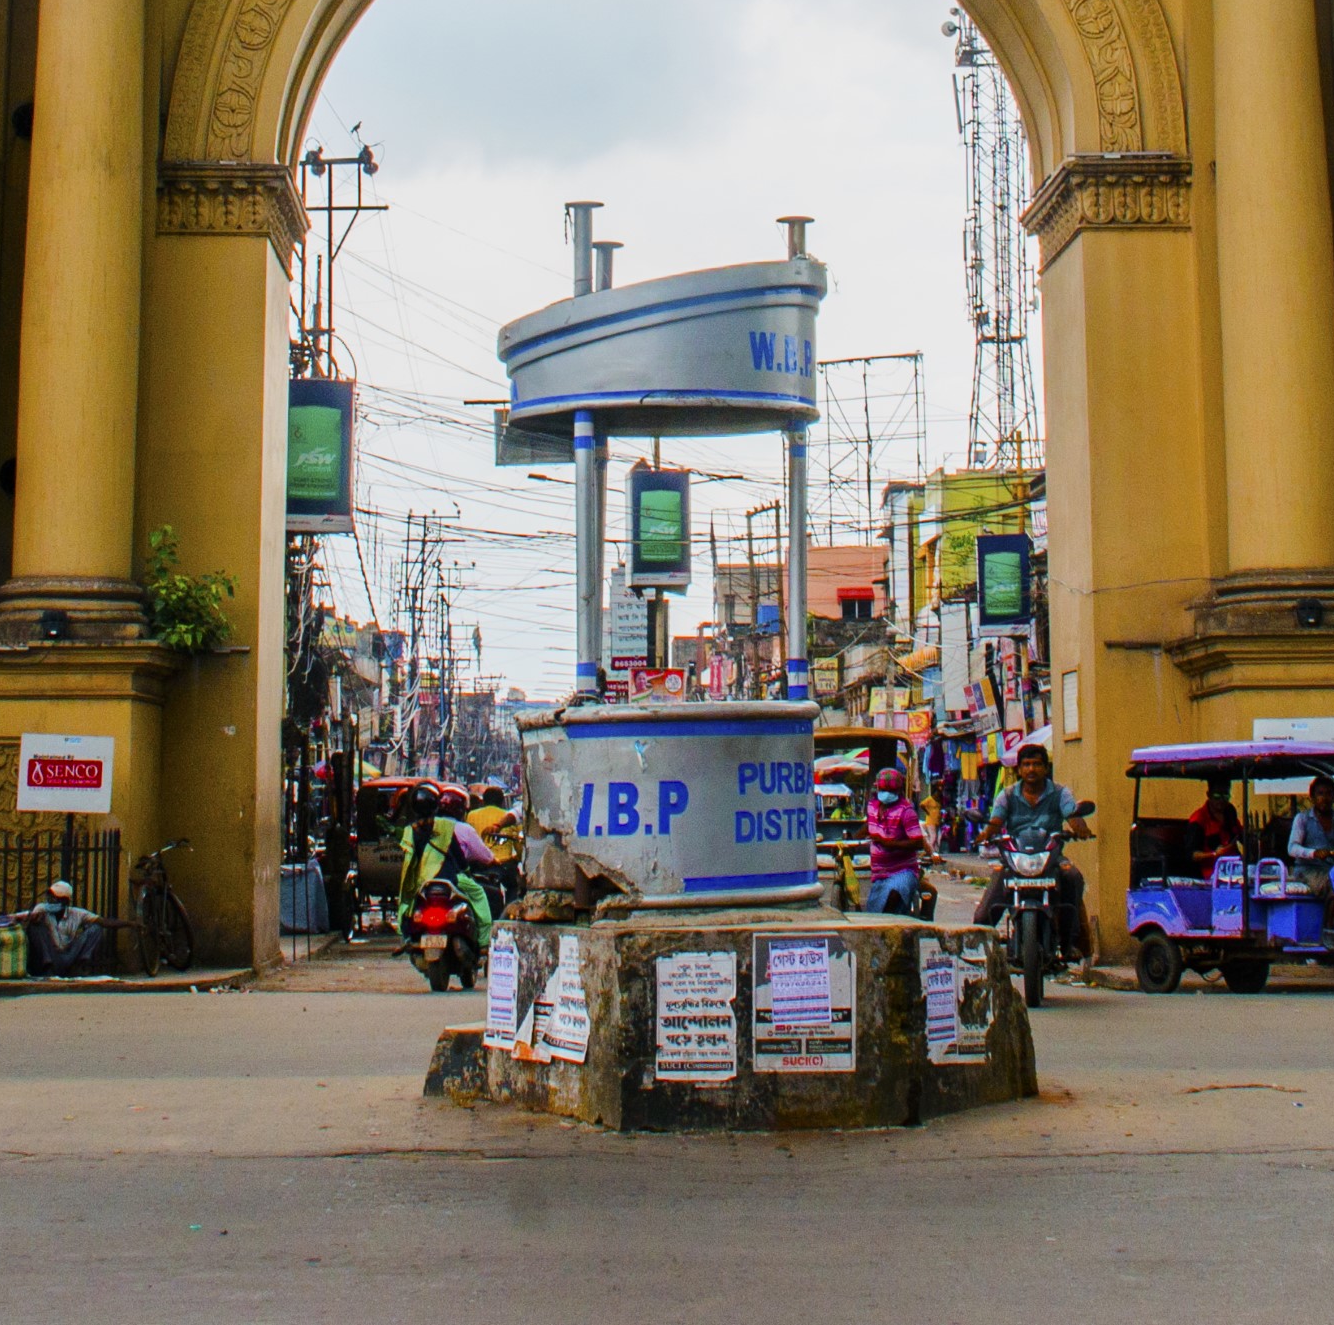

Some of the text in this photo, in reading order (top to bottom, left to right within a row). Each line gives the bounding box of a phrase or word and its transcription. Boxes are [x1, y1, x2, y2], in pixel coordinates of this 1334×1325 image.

[46, 764, 99, 779] SENCO
[659, 1015, 732, 1031] আন্দোলন
[666, 1034, 692, 1047] গড়ে
[782, 1055, 824, 1066] SUCI(C)
